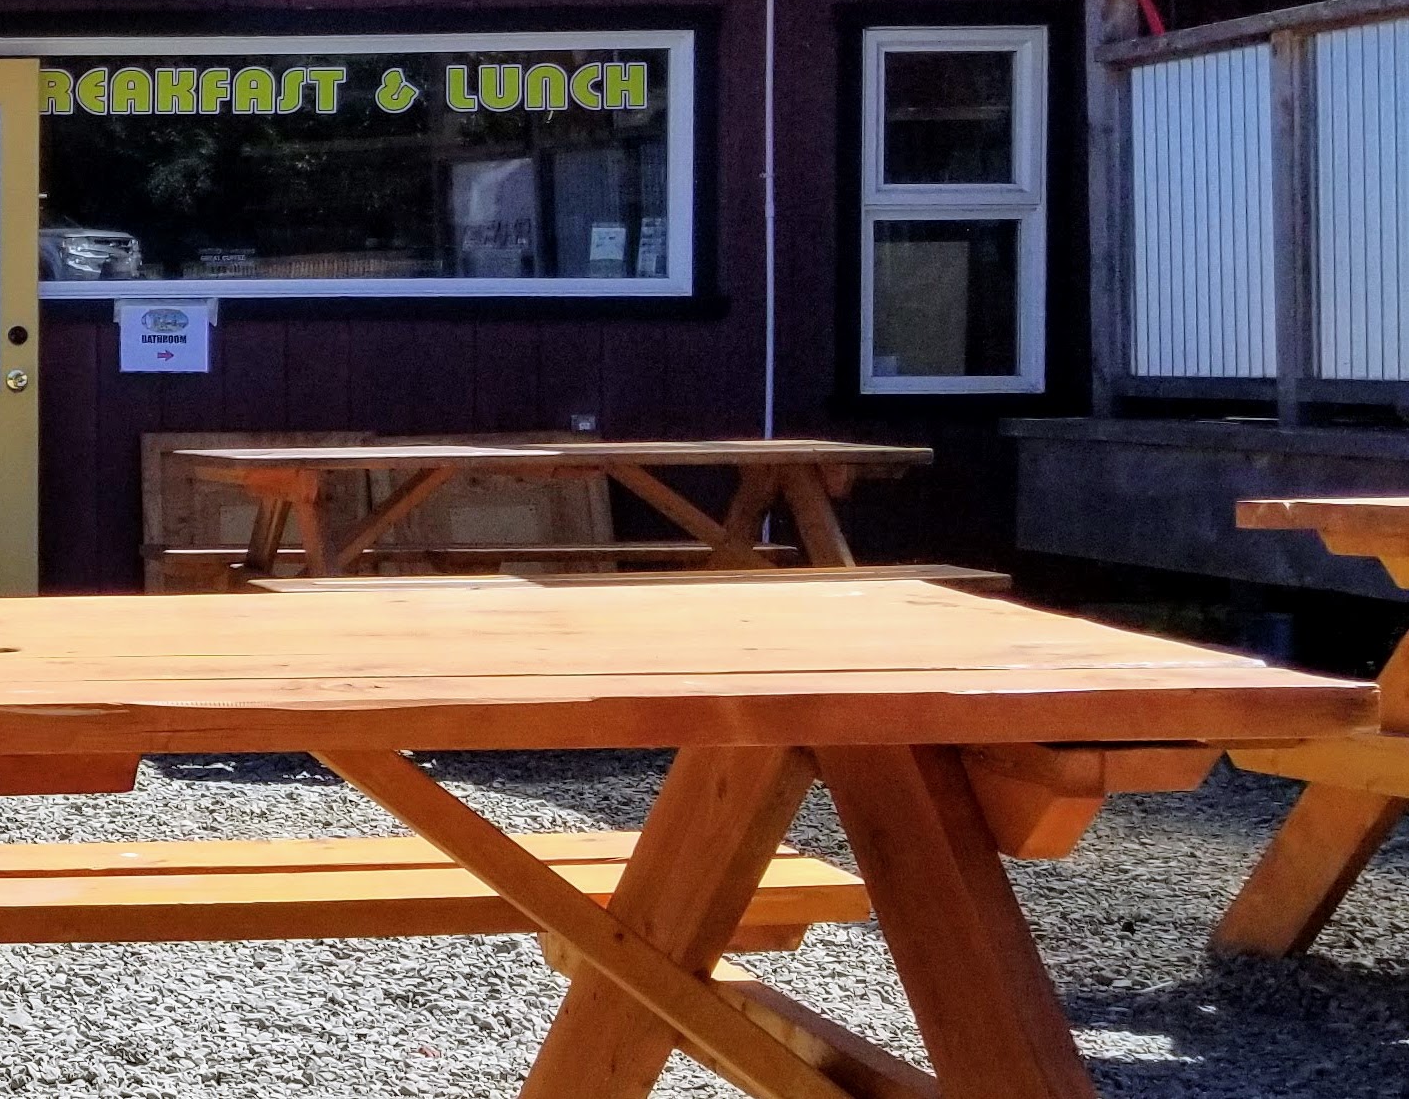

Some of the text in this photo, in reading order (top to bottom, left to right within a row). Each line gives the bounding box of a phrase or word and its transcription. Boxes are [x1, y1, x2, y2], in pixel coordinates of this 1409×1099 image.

[39, 62, 648, 115] REAKFAST & LUNCH
[141, 334, 187, 344] BATHROOM
